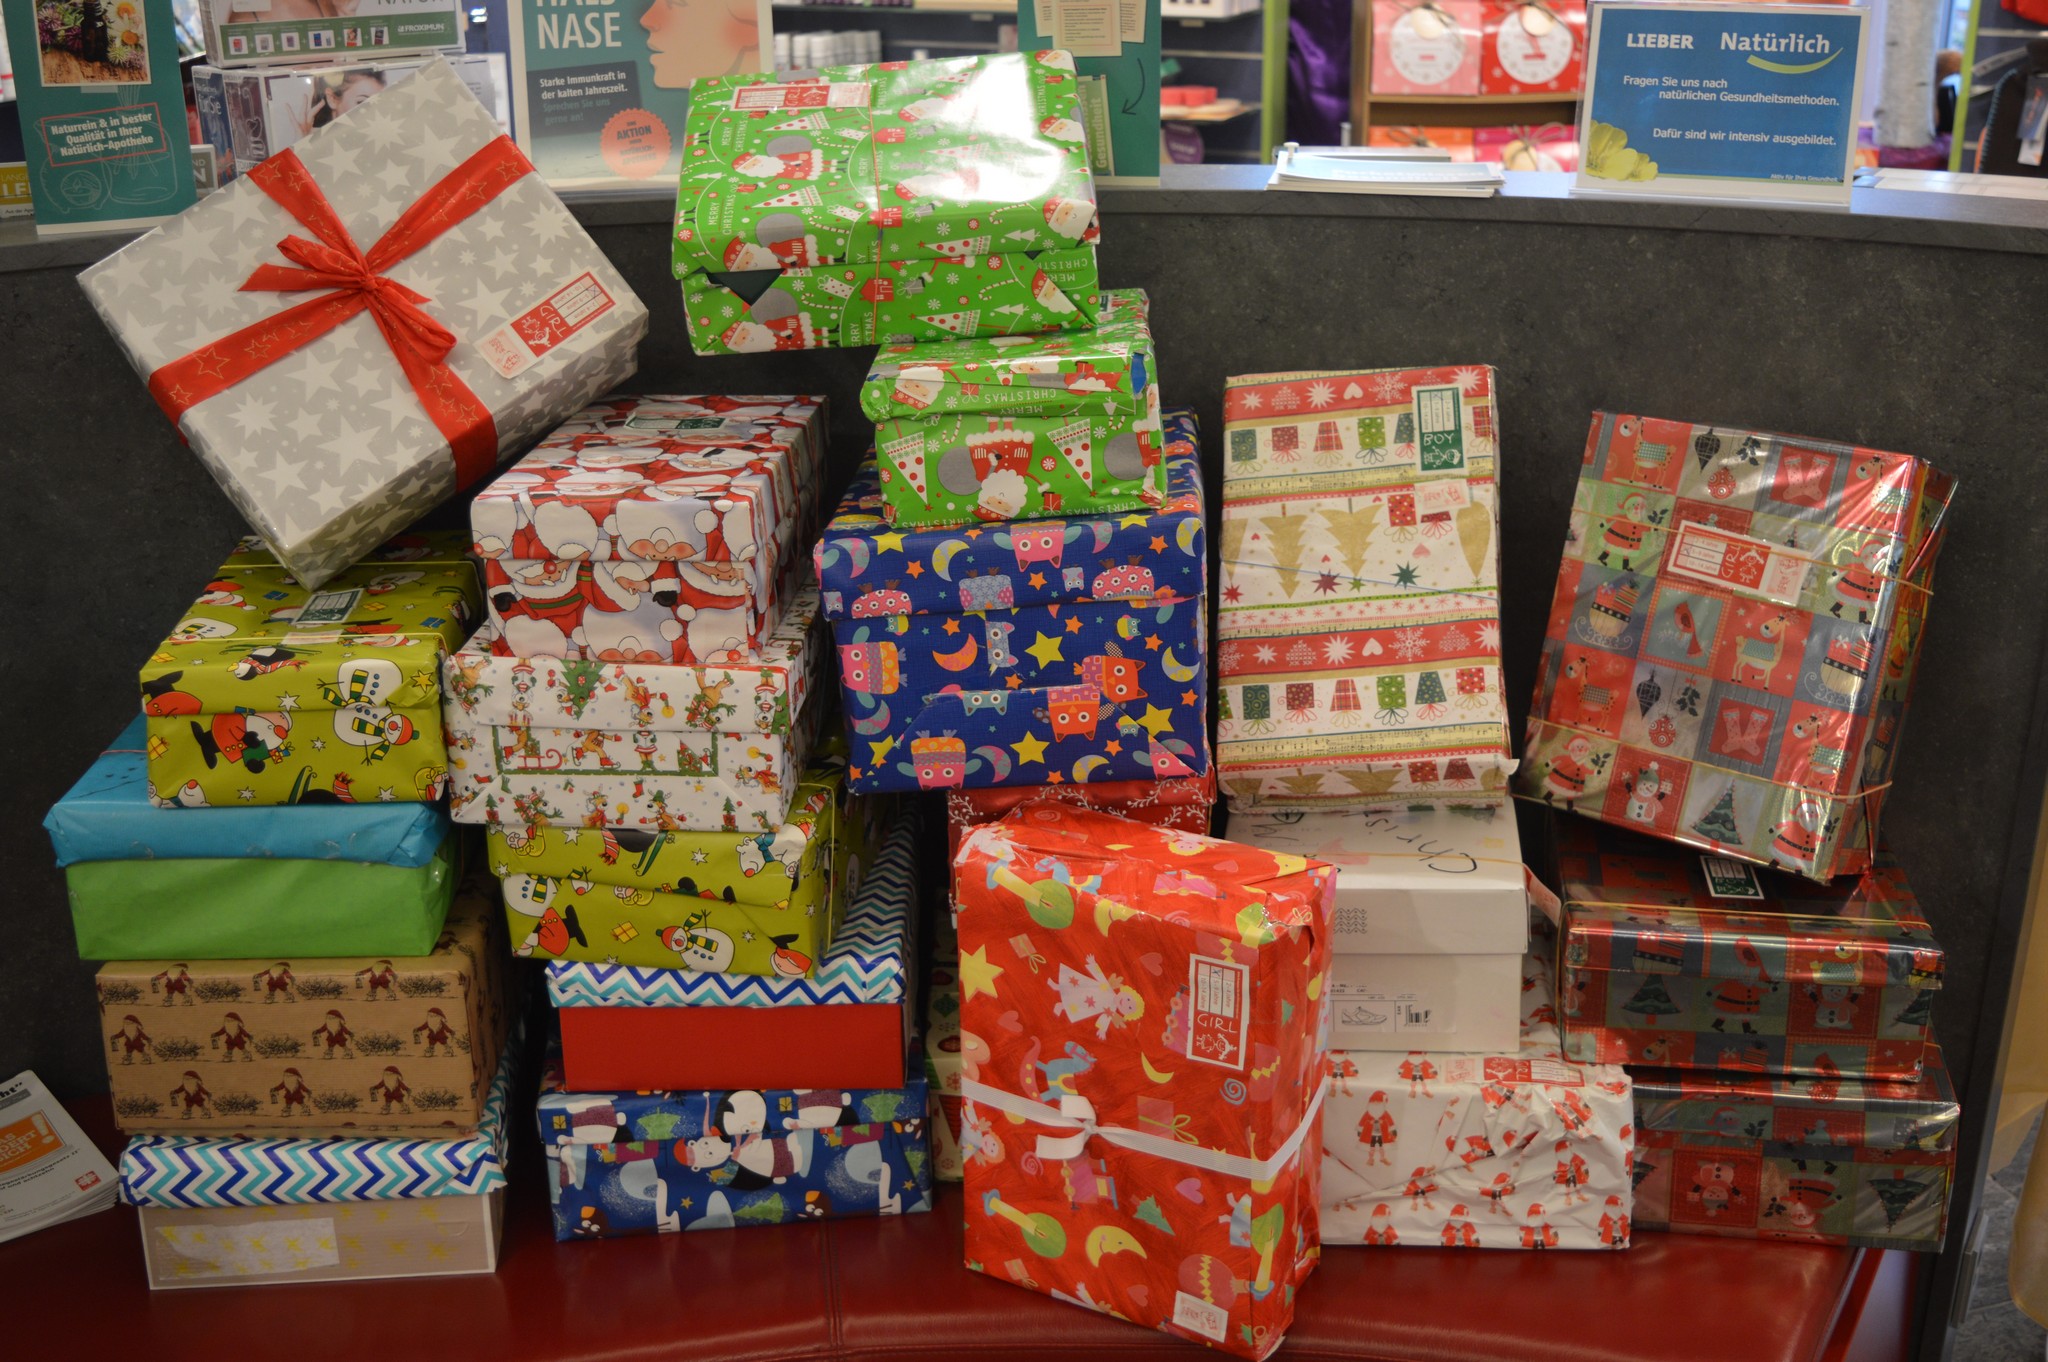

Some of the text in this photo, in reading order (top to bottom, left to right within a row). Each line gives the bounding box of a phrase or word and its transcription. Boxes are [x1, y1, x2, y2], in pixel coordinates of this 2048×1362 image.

[537, 12, 622, 49] NASE
[1627, 32, 1830, 53] LIEBER Natürlich
[540, 71, 626, 88] Starke Immunkraft in
[1623, 75, 1728, 88] Fragen Sie uns nach
[541, 84, 628, 100] der kalten Jahreszeit.
[1659, 90, 1840, 106] natürlichen Gesundheitsmethoden.
[51, 113, 152, 135] Naturrein & in bester
[617, 125, 652, 140] AKTION
[66, 126, 142, 145] Qualität in Ihrer
[722, 127, 732, 146] MERRY
[734, 120, 748, 152] CHRISTMAS
[1653, 128, 1837, 146] Dafür sind wir intensiv ausgebildet.
[60, 135, 154, 157] Natürlich-Apotheke
[708, 202, 720, 226] MERRY
[722, 194, 737, 235] CHRISTMAS
[1049, 273, 1076, 283] MER
[540, 306, 566, 337] GIRL
[849, 323, 861, 347] ERRY
[985, 388, 1057, 404] CHRISTMAS
[1000, 405, 1043, 415] MERRY
[1424, 433, 1454, 446] BOY
[1066, 501, 1137, 515] CHRISTMAS
[902, 517, 972, 529] CHRISTMAS
[1722, 543, 1741, 578] GIRL
[1197, 1014, 1238, 1033] GIRL
